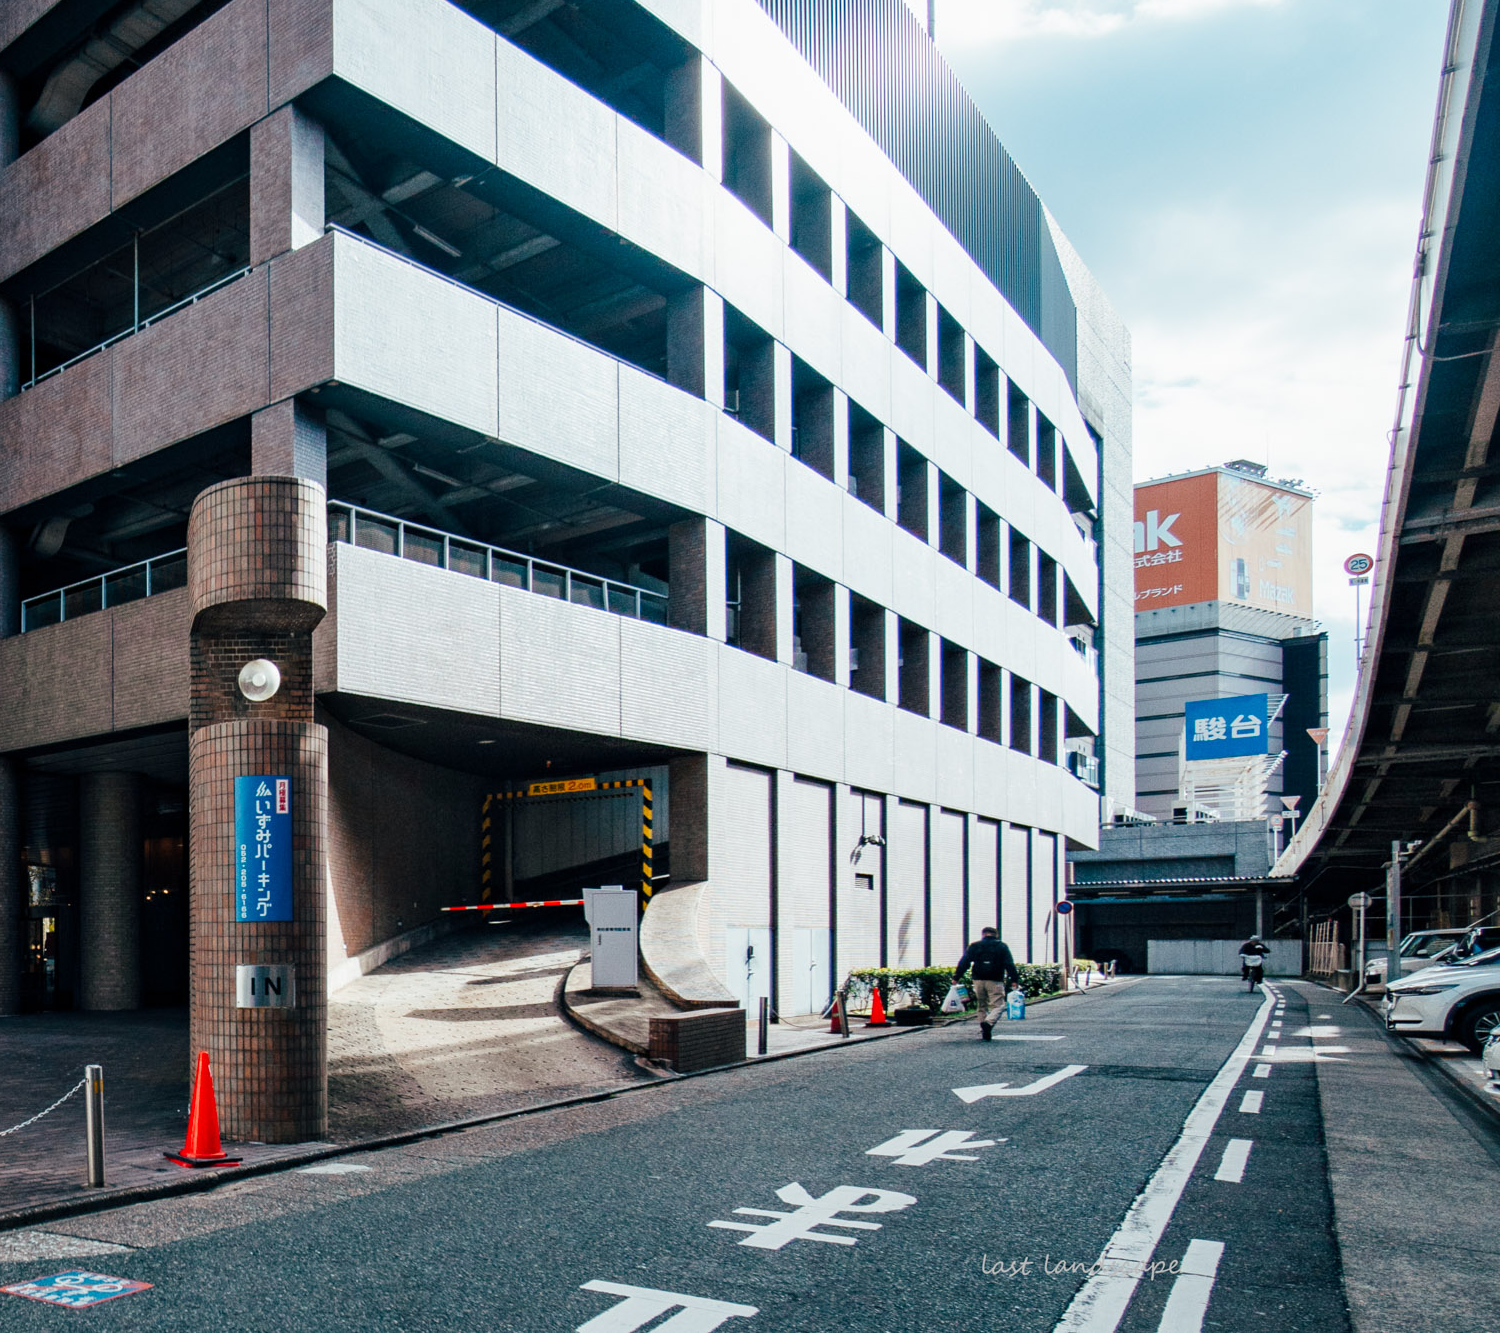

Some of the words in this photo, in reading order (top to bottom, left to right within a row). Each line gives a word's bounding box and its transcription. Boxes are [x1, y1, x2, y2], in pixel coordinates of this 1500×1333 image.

[1350, 558, 1368, 571] 25
[1259, 578, 1295, 604] Mazak
[1193, 714, 1262, 742] 駿台
[255, 799, 273, 917] いずみパーキング
[251, 977, 281, 995] IN
